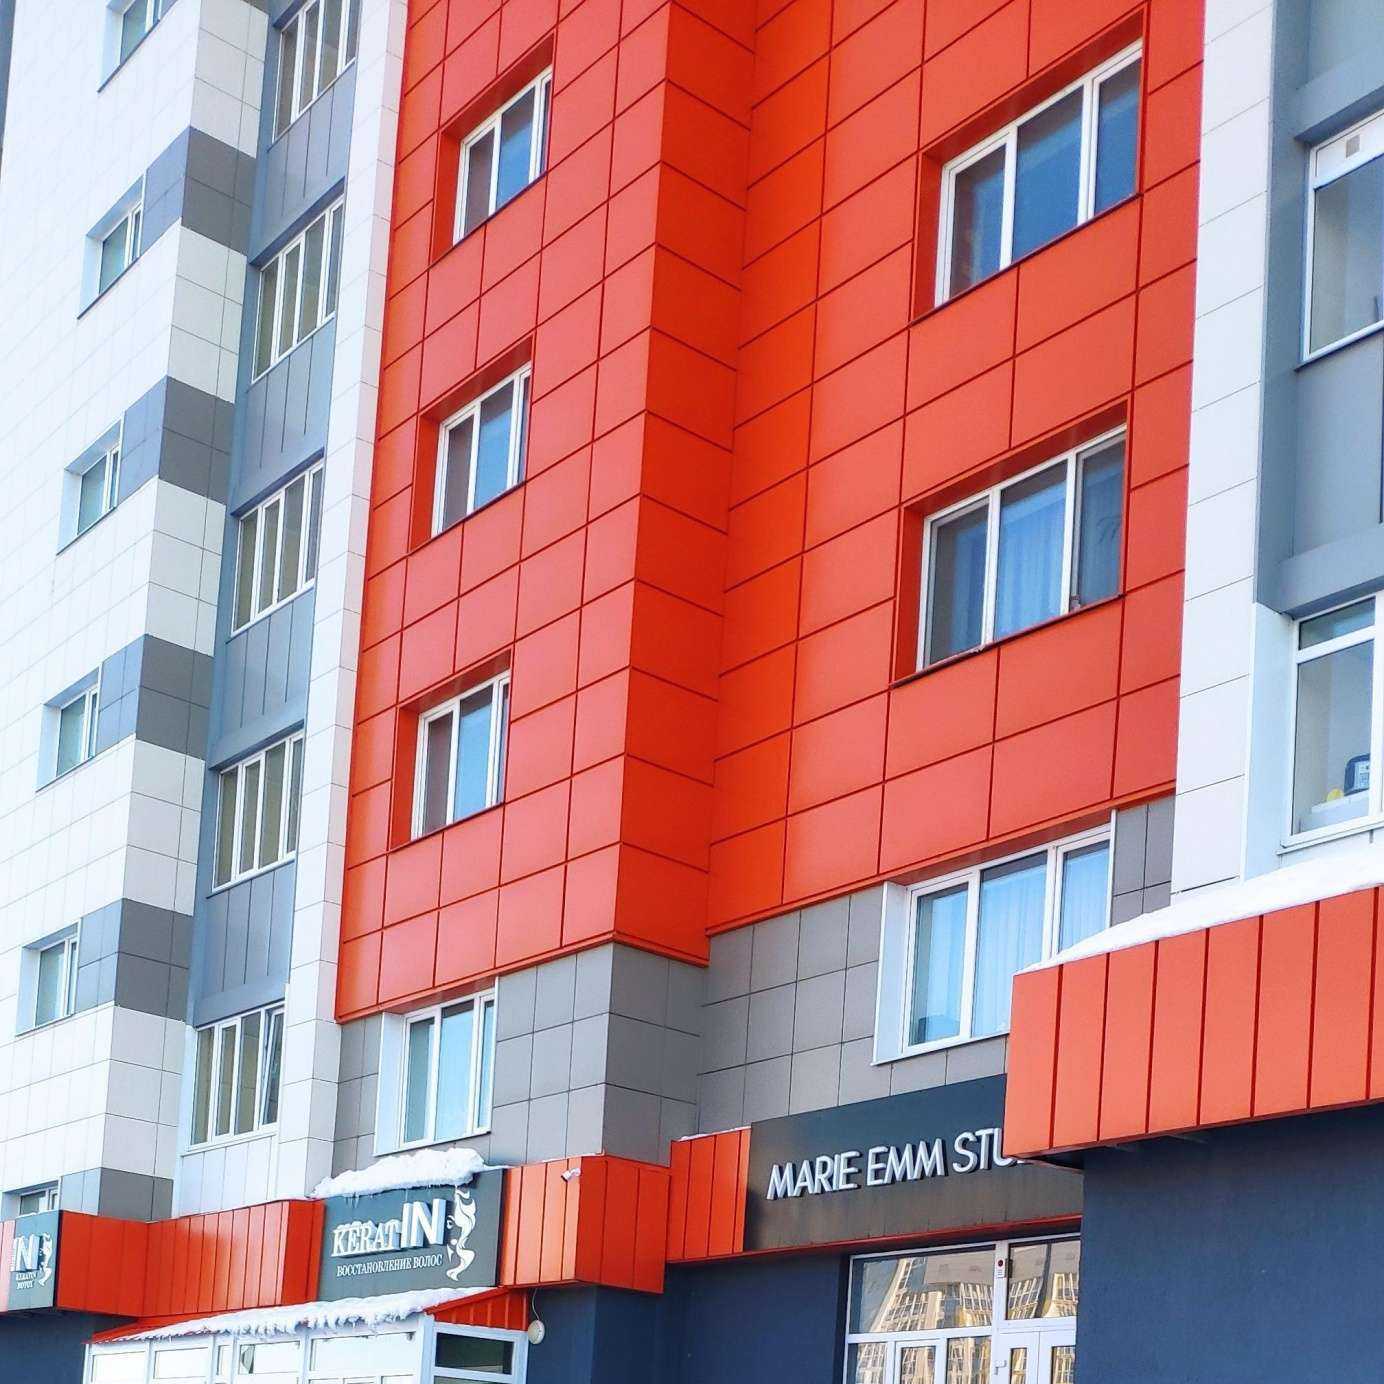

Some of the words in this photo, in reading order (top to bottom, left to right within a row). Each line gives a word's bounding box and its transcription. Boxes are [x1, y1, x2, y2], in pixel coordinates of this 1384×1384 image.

[766, 1150, 861, 1200] MARIE
[866, 1137, 946, 1187] EMM
[952, 1127, 1025, 1174] STU
[336, 1258, 412, 1277] ВОССТАНОВЛЕНИЕ
[413, 1254, 443, 1269] ВОЛОС
